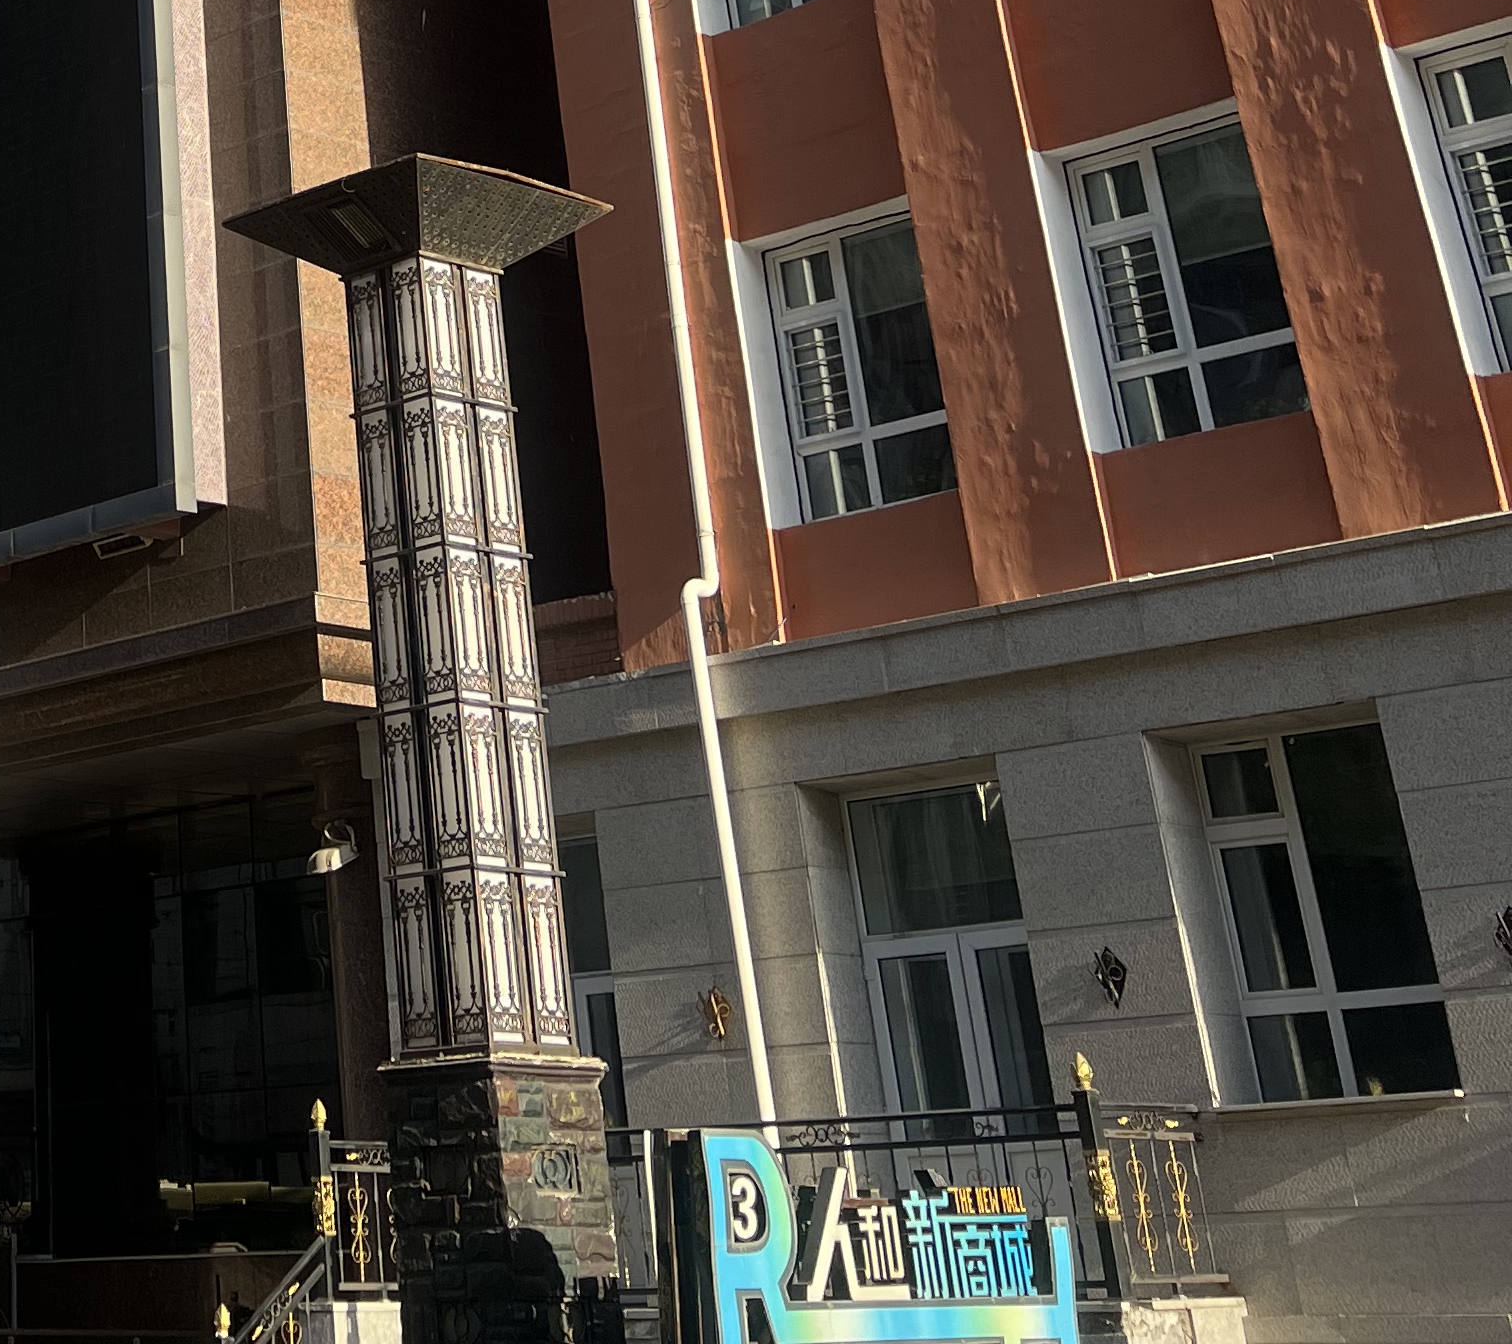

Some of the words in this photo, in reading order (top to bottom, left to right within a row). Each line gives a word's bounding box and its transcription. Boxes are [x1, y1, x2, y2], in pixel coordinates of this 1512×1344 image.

[731, 1176, 758, 1241] 3
[947, 1186, 974, 1214] THE
[975, 1187, 999, 1214] NEW
[1001, 1186, 1027, 1213] MALL
